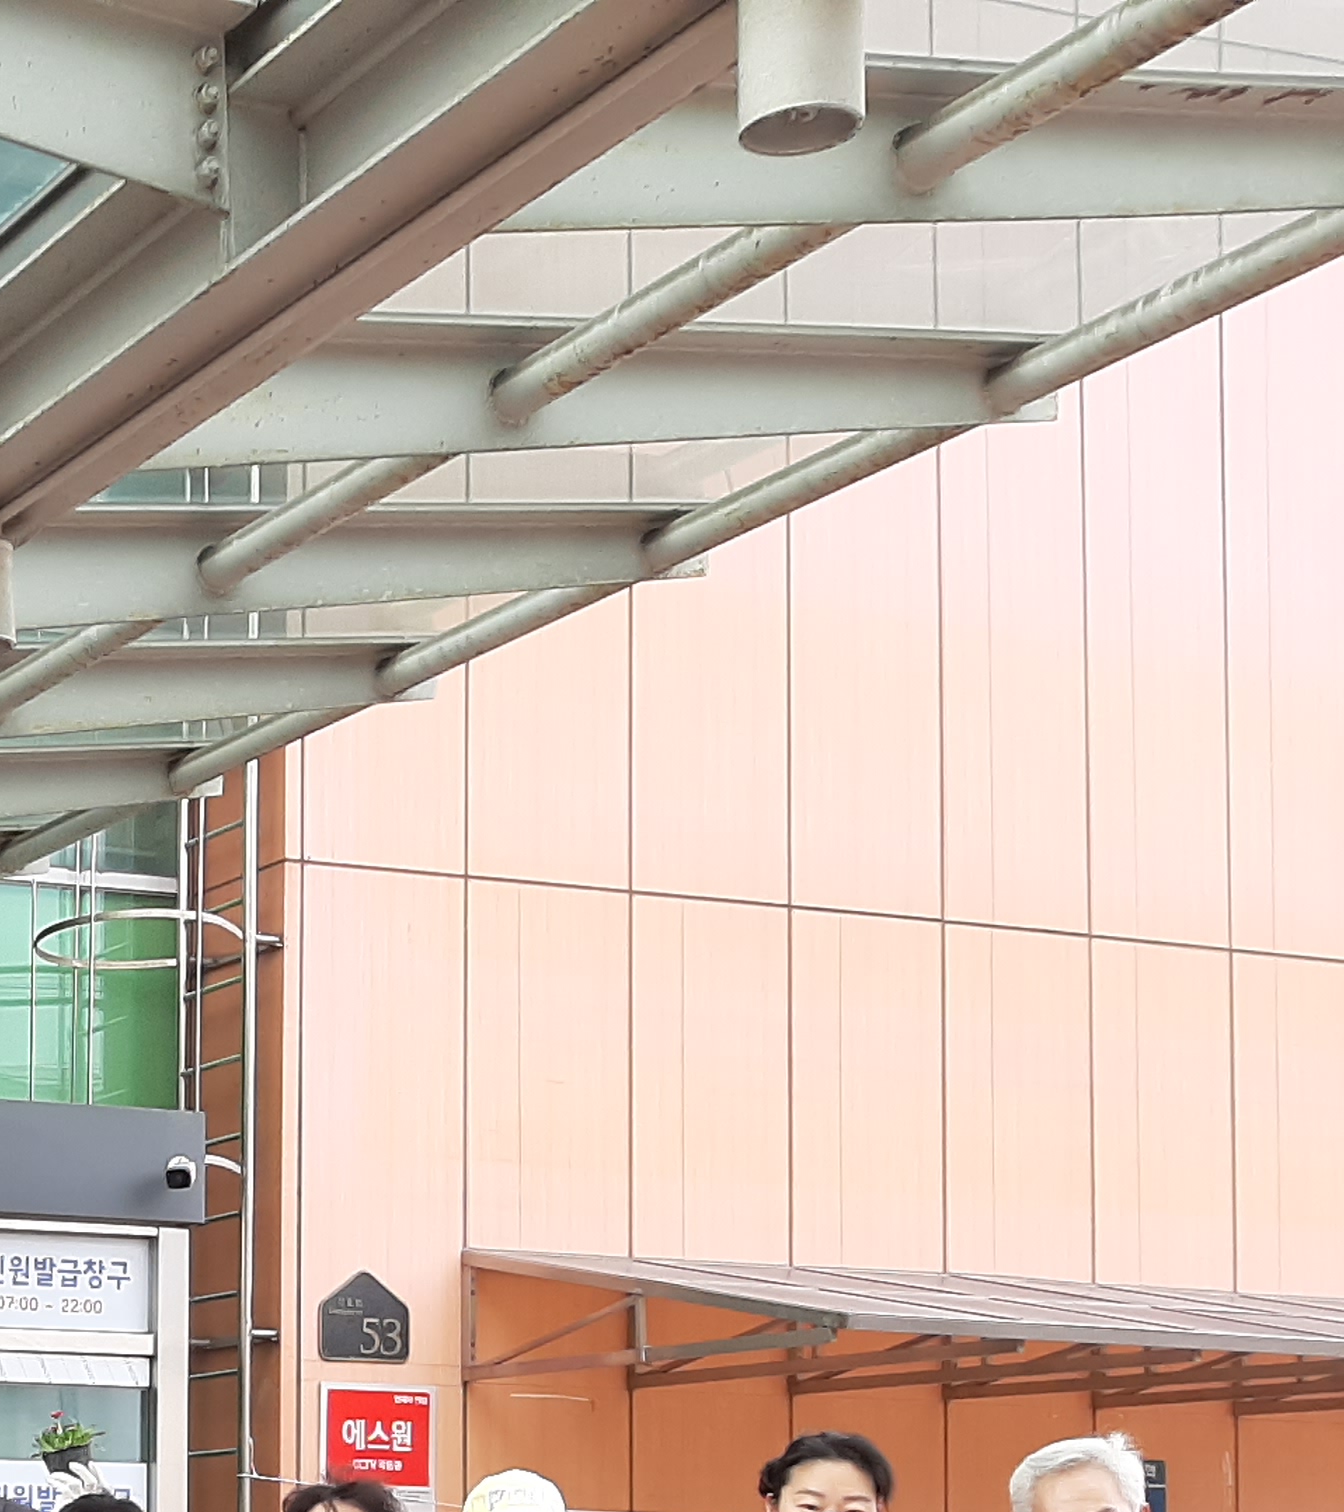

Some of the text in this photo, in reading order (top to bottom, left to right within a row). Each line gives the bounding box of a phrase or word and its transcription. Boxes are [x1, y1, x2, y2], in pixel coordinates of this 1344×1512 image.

[60, 1298, 103, 1315] 22:00
[360, 1317, 402, 1356] 53
[341, 1418, 413, 1452] 에스원
